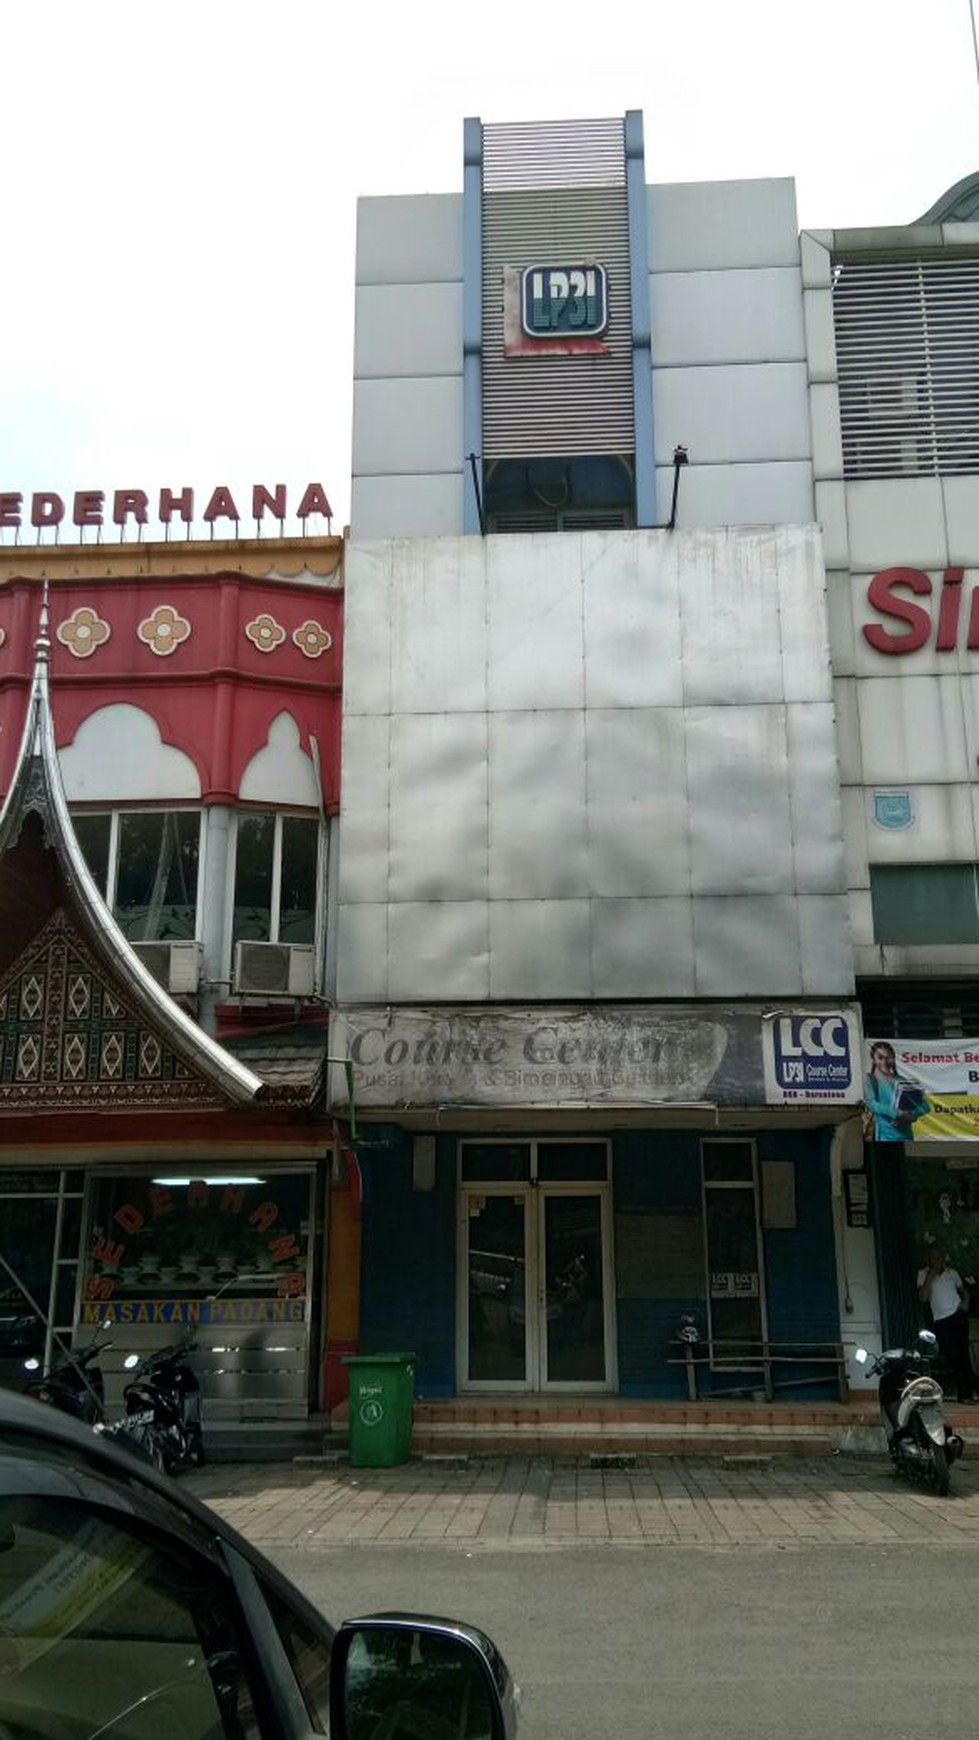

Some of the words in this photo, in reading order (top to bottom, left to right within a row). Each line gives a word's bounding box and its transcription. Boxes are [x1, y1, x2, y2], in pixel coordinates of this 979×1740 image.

[351, 1027, 508, 1066] Course
[779, 1017, 846, 1057] LCC
[902, 1052, 960, 1064] Selamat
[968, 1070, 979, 1083] B
[83, 1301, 200, 1323] MASAKAN
[210, 1301, 303, 1322] PADANG
